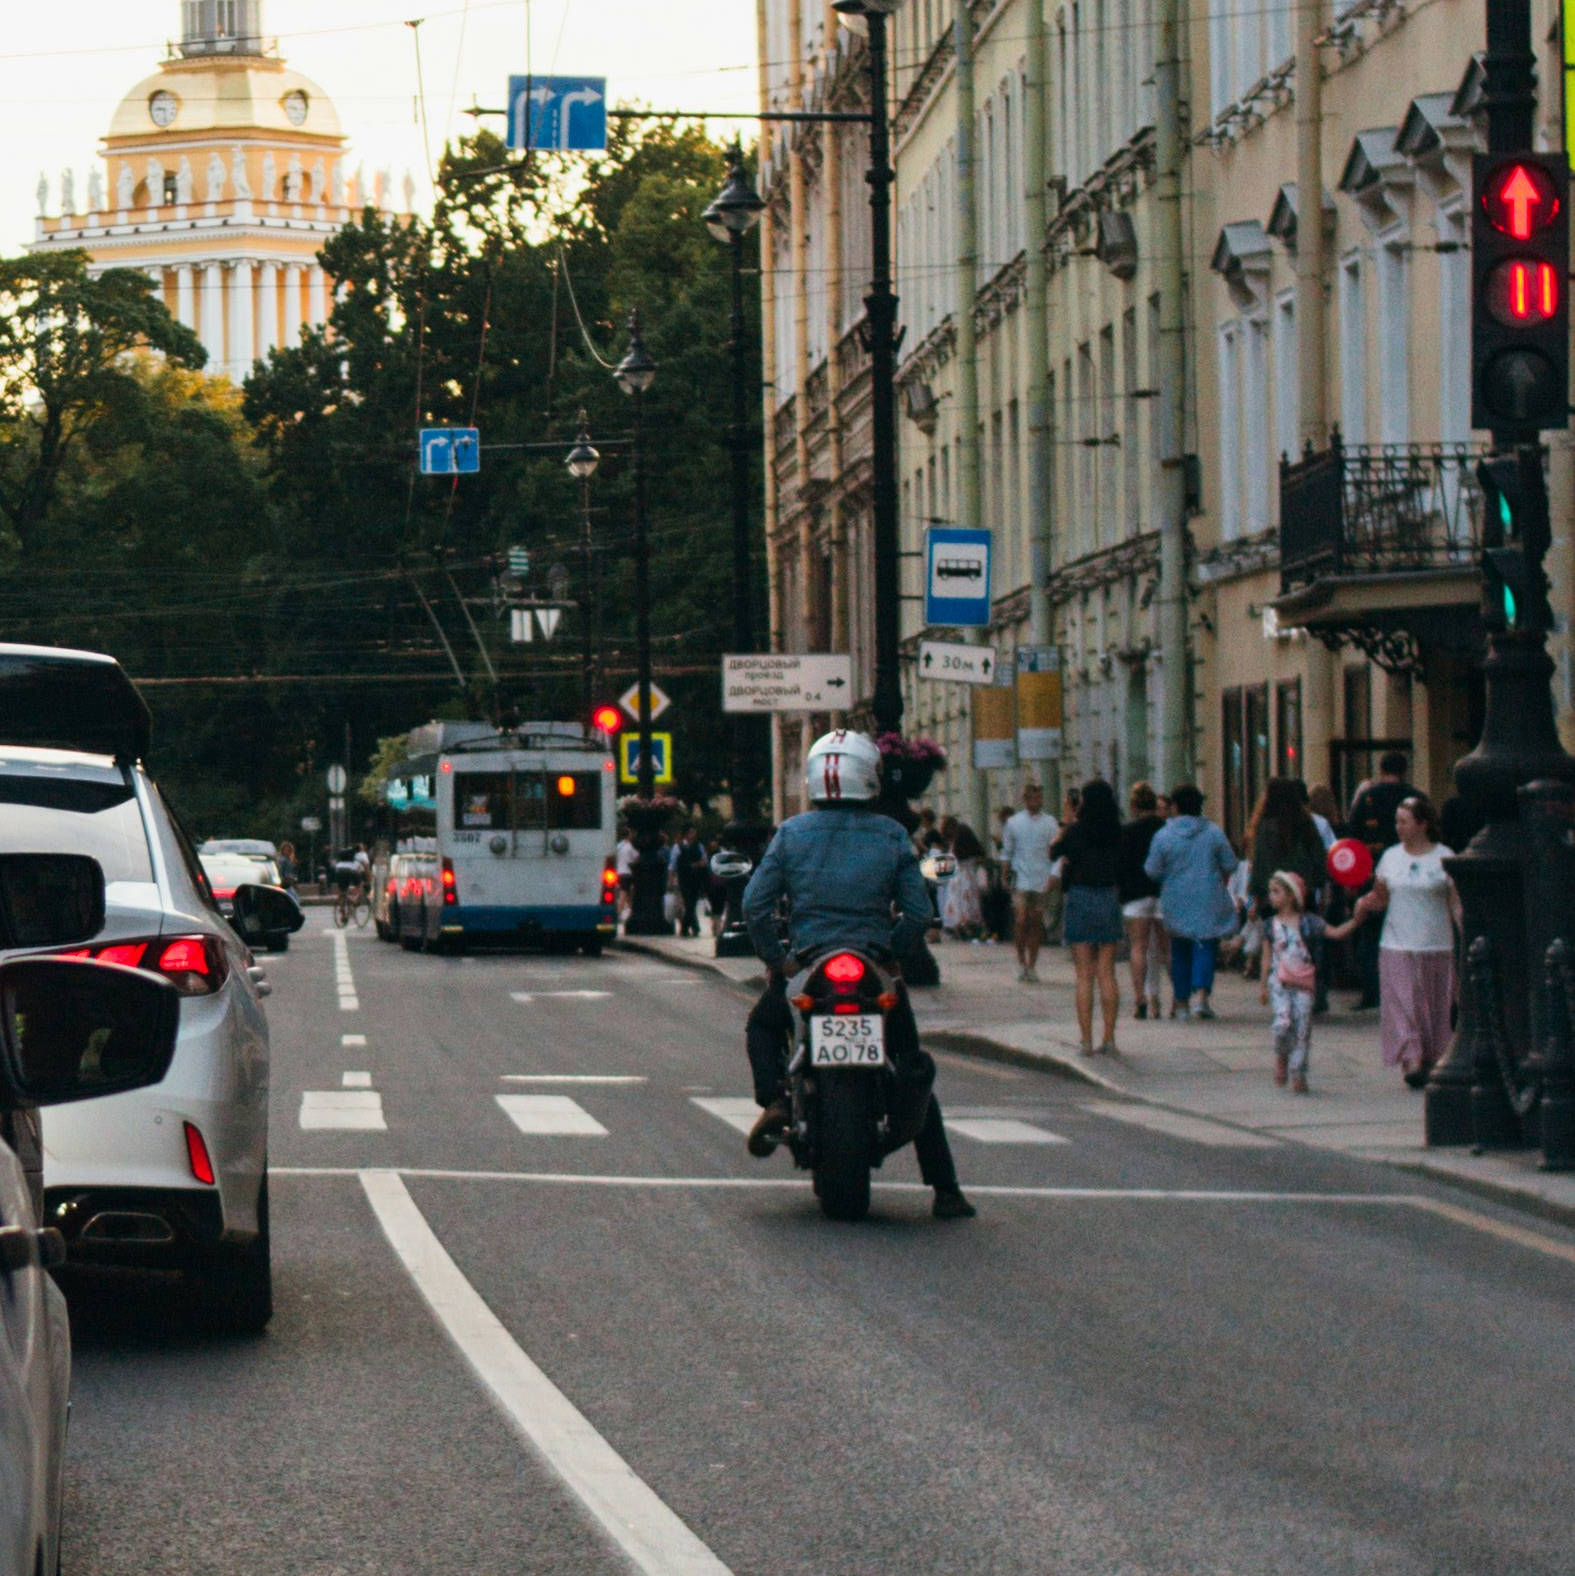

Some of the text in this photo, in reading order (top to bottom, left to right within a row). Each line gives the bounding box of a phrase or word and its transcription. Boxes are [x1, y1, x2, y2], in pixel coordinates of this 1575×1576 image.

[728, 658, 801, 670] ДВОРЦОВЫЙ
[744, 671, 784, 681] проезд
[728, 685, 801, 697] ДВОРЦОВЫЙ
[752, 697, 779, 706] мост
[821, 1016, 873, 1037] 5235
[854, 1044, 879, 1061] 78
